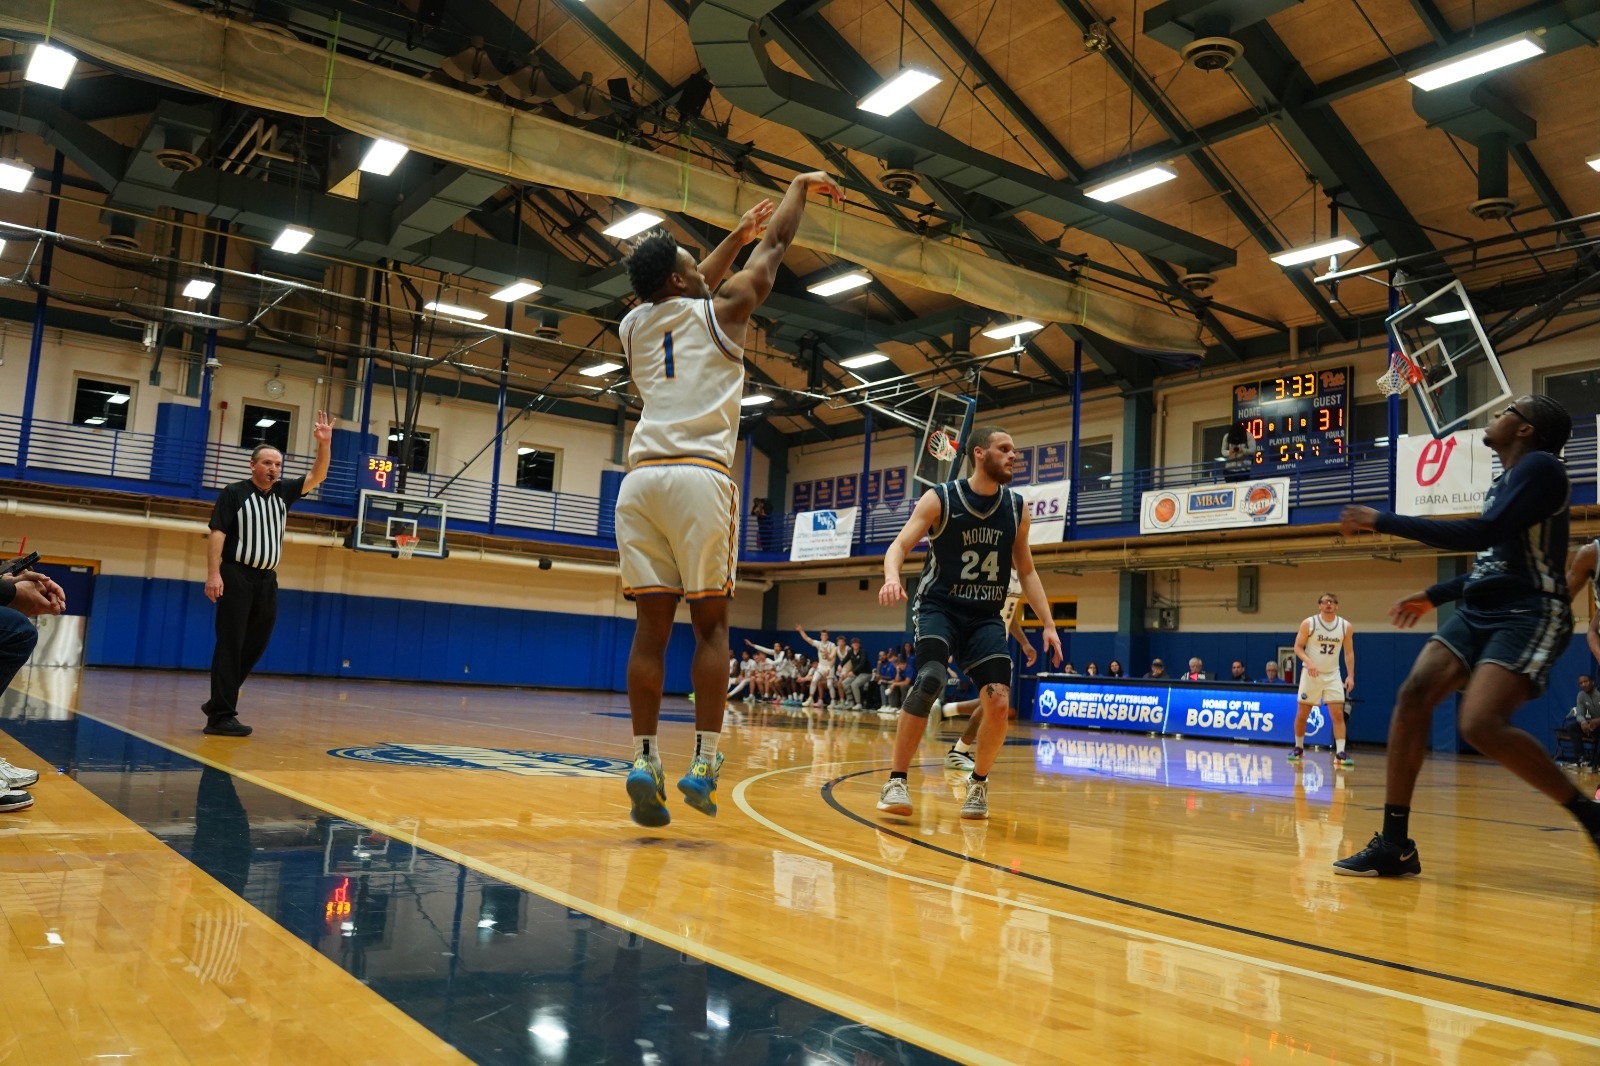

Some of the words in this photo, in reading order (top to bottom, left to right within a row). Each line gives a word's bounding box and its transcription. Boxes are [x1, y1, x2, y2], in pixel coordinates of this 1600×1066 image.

[663, 331, 675, 378] 1
[1276, 374, 1314, 399] 3:33
[1321, 372, 1345, 387] Pitt
[1313, 394, 1342, 408] GUEST
[1238, 407, 1261, 418] HOME
[1319, 408, 1343, 430] 31
[1288, 417, 1292, 431] 1
[1269, 437, 1290, 446] PLAYER
[1325, 430, 1345, 439] FOULS
[375, 471, 387, 488] 9
[1196, 493, 1228, 507] MBAC
[1415, 494, 1449, 505] EBARA
[962, 527, 1003, 546] MOUNT
[960, 550, 1000, 581] 24
[949, 584, 1004, 600] ALOYSIUS
[1320, 644, 1335, 654] 32
[1065, 691, 1103, 702] UNIVERSITY
[1104, 693, 1115, 703] OF
[1115, 694, 1158, 705] PITTSBURGH
[1202, 699, 1228, 709] HOME
[1229, 700, 1242, 710] OF
[1243, 701, 1260, 711] THE
[1057, 700, 1163, 723] GREENSBURG
[1186, 708, 1274, 732] BOBCATS
